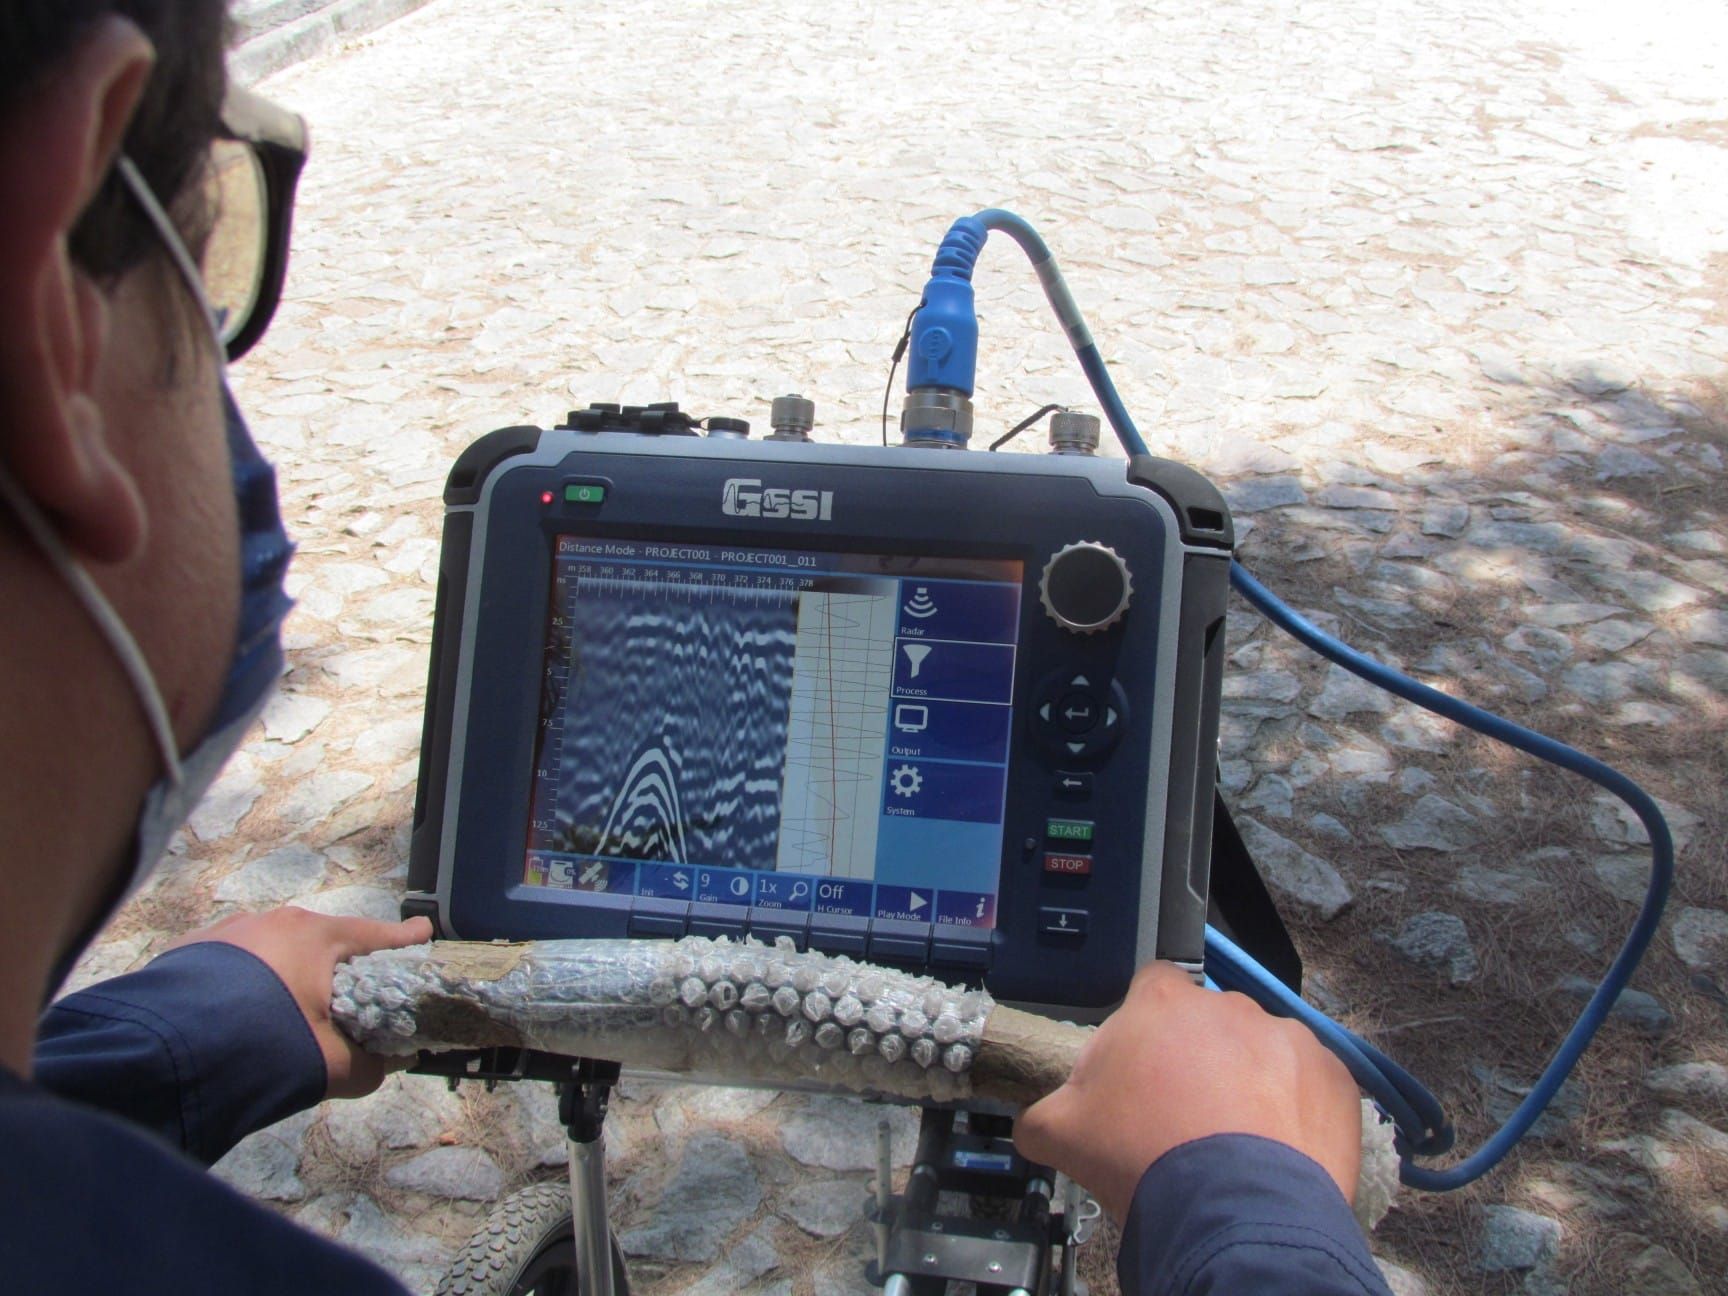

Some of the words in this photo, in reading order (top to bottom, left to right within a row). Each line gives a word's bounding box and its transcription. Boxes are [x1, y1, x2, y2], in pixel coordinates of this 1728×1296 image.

[721, 478, 834, 521] GSSI
[559, 541, 603, 554] Distance
[605, 544, 636, 556] Mode
[645, 546, 711, 561] PROJECT001
[600, 566, 614, 575] 360
[622, 567, 636, 576] 362
[644, 568, 658, 577] 364
[666, 570, 681, 579] 366
[689, 571, 703, 580] 368
[711, 573, 726, 582] 370
[734, 574, 748, 583] 372
[757, 575, 771, 584] 374
[780, 577, 794, 586] 376
[799, 578, 814, 587] 378
[901, 626, 925, 636] Radar
[896, 686, 928, 696] Process
[891, 746, 921, 757] Output
[537, 769, 547, 777] 10
[887, 806, 915, 817] System
[1049, 824, 1089, 837] START
[1051, 858, 1084, 871] STOP
[700, 873, 711, 888] 9
[759, 879, 778, 895] 1x
[819, 883, 845, 900] Off
[699, 893, 718, 903] Gain
[758, 900, 782, 910] Zoom
[817, 904, 826, 913] H
[827, 905, 853, 915] Cursor
[878, 909, 897, 921] Play
[897, 911, 921, 922] Mode
[938, 914, 953, 925] File
[955, 917, 972, 926] Info
